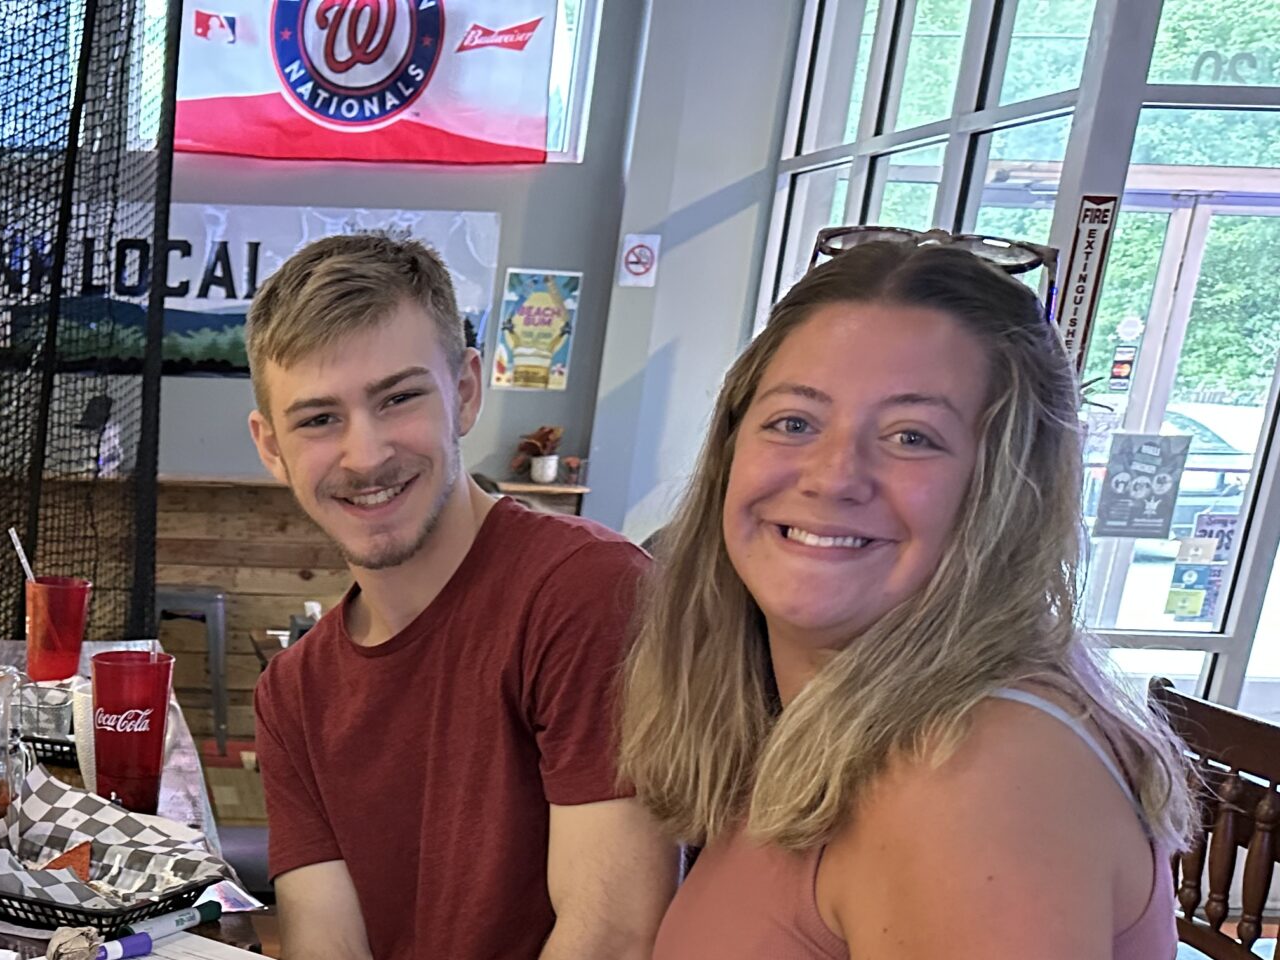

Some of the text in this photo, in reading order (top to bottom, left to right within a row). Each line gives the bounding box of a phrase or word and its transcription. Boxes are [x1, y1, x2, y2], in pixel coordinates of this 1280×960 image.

[284, 59, 425, 118] NATIONALS
[1081, 208, 1111, 224] FIRE
[81, 236, 263, 300] LOCAL
[1064, 228, 1098, 354] EXTINGUISHE
[517, 305, 562, 317] BEACH
[523, 316, 553, 326] BUM
[94, 707, 154, 733] Coca-Cola
